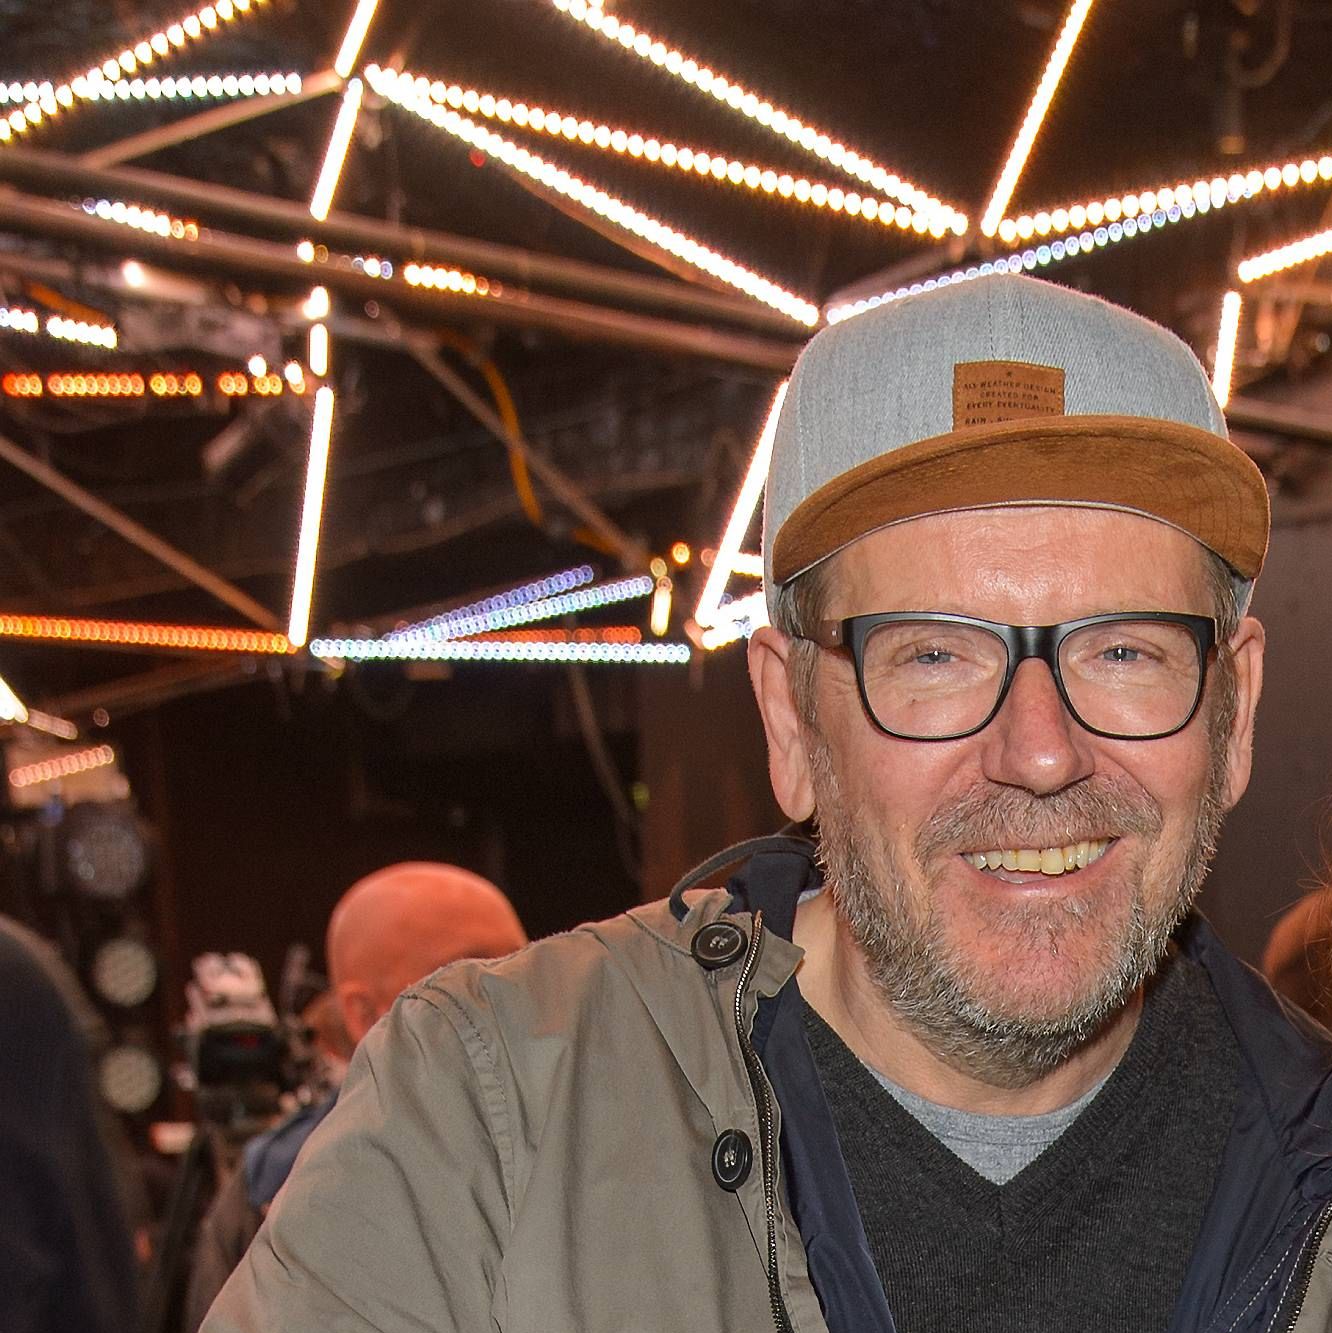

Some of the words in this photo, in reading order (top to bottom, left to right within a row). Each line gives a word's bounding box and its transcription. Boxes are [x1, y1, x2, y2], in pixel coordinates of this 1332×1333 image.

[980, 380, 1021, 389] WEATHER
[1024, 384, 1056, 394] DESIGN
[980, 391, 1019, 400] CREATED
[1022, 392, 1039, 401] FOR
[967, 402, 992, 410] EVERY
[997, 401, 1055, 413] EVENTUALITY
